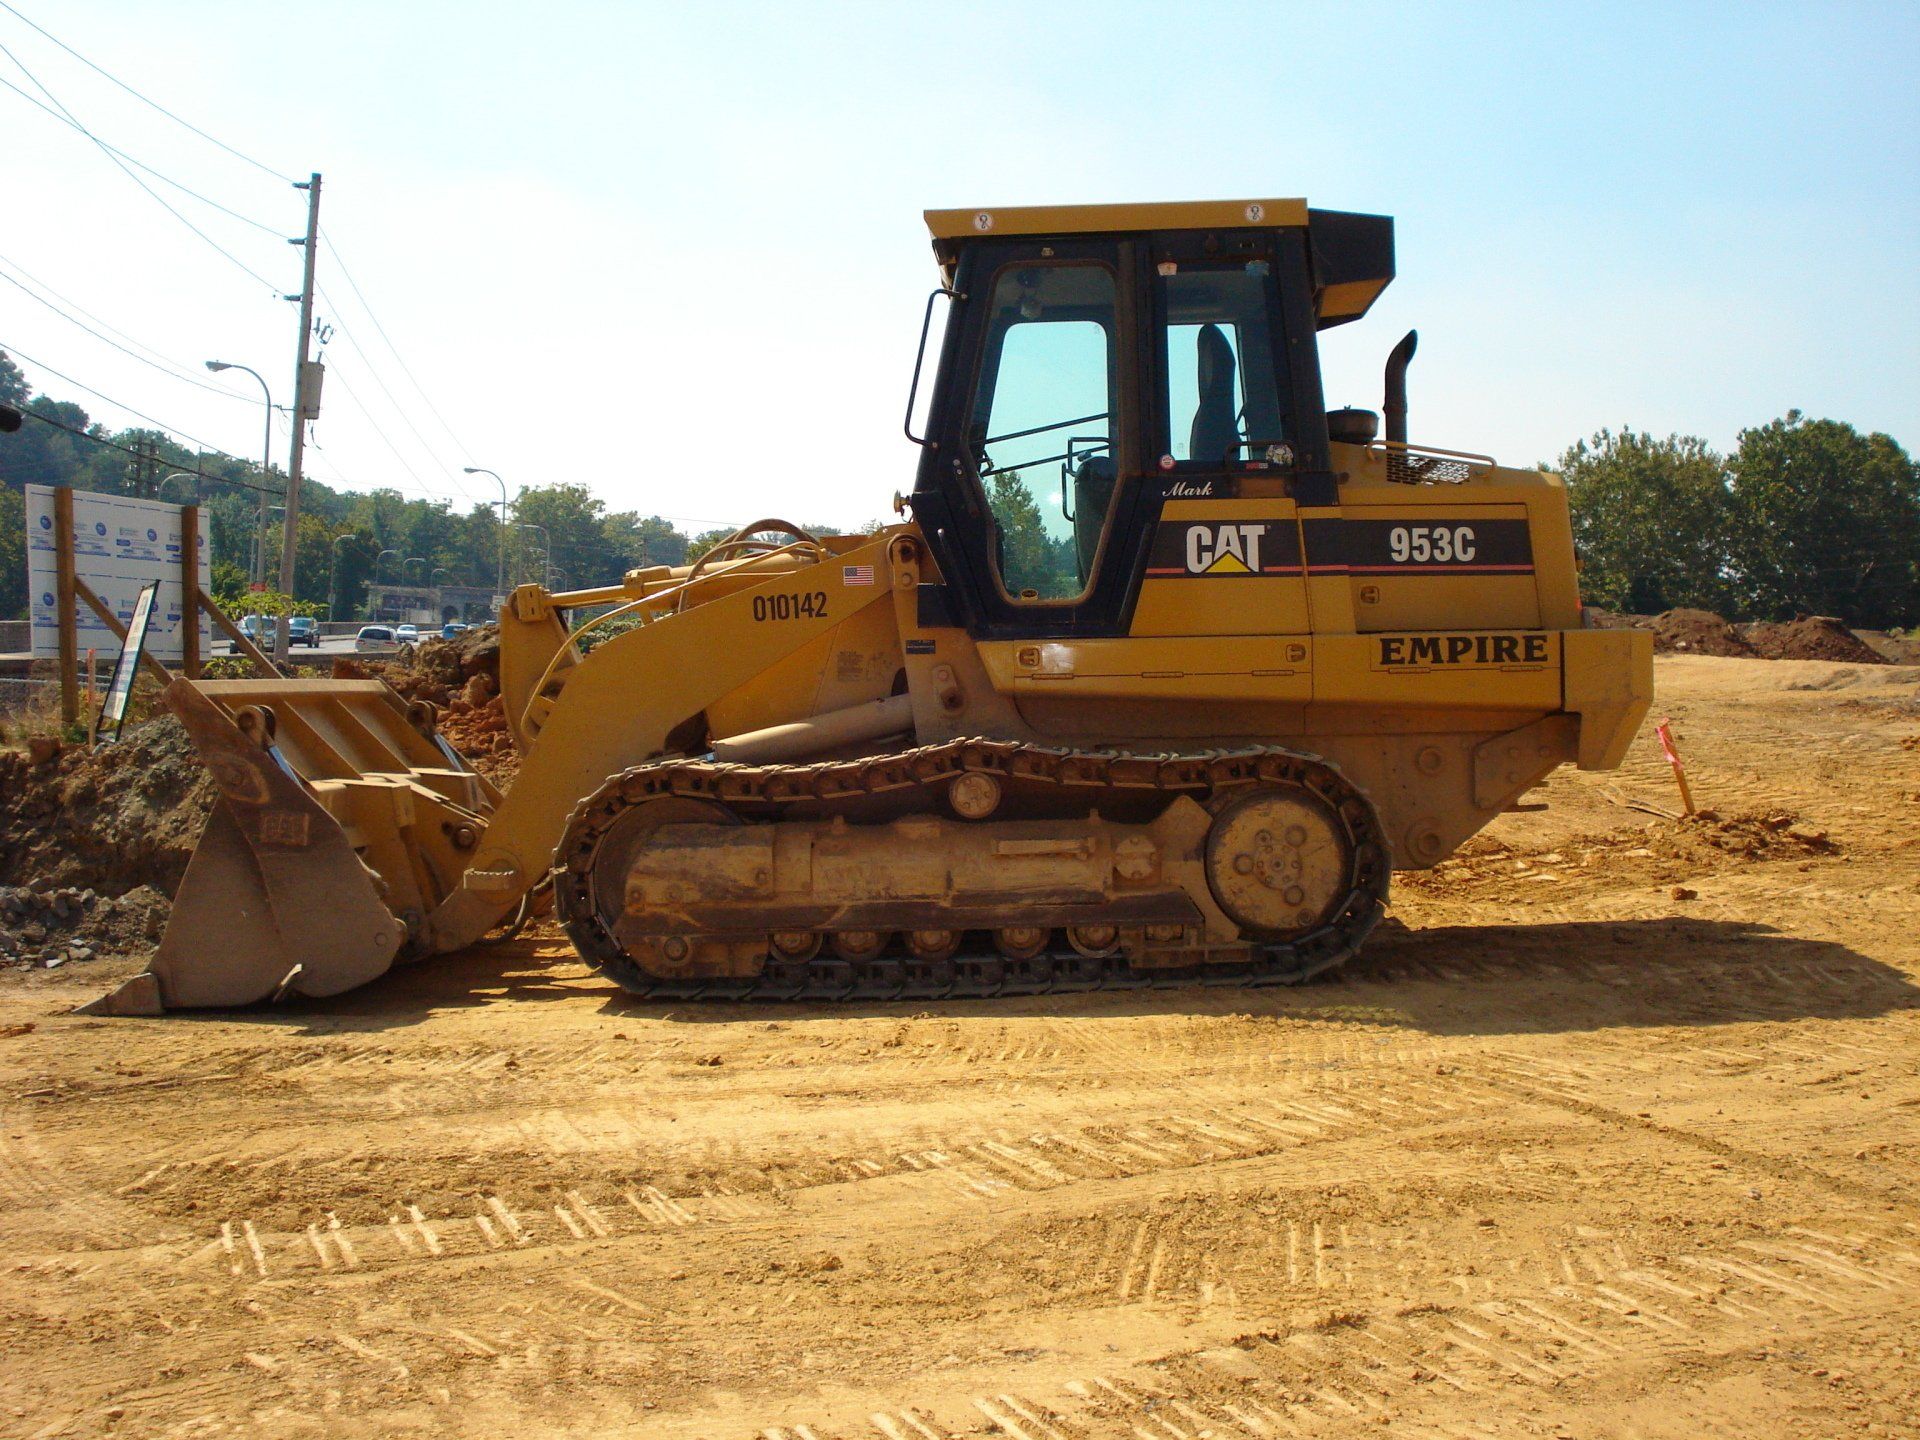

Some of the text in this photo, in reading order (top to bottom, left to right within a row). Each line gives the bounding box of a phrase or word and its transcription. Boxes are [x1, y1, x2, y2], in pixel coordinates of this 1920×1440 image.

[1162, 481, 1214, 497] Mark
[1186, 525, 1266, 573] CAT
[1389, 527, 1476, 562] 953C
[753, 592, 828, 622] 010142
[1379, 635, 1549, 666] EMPIRE
